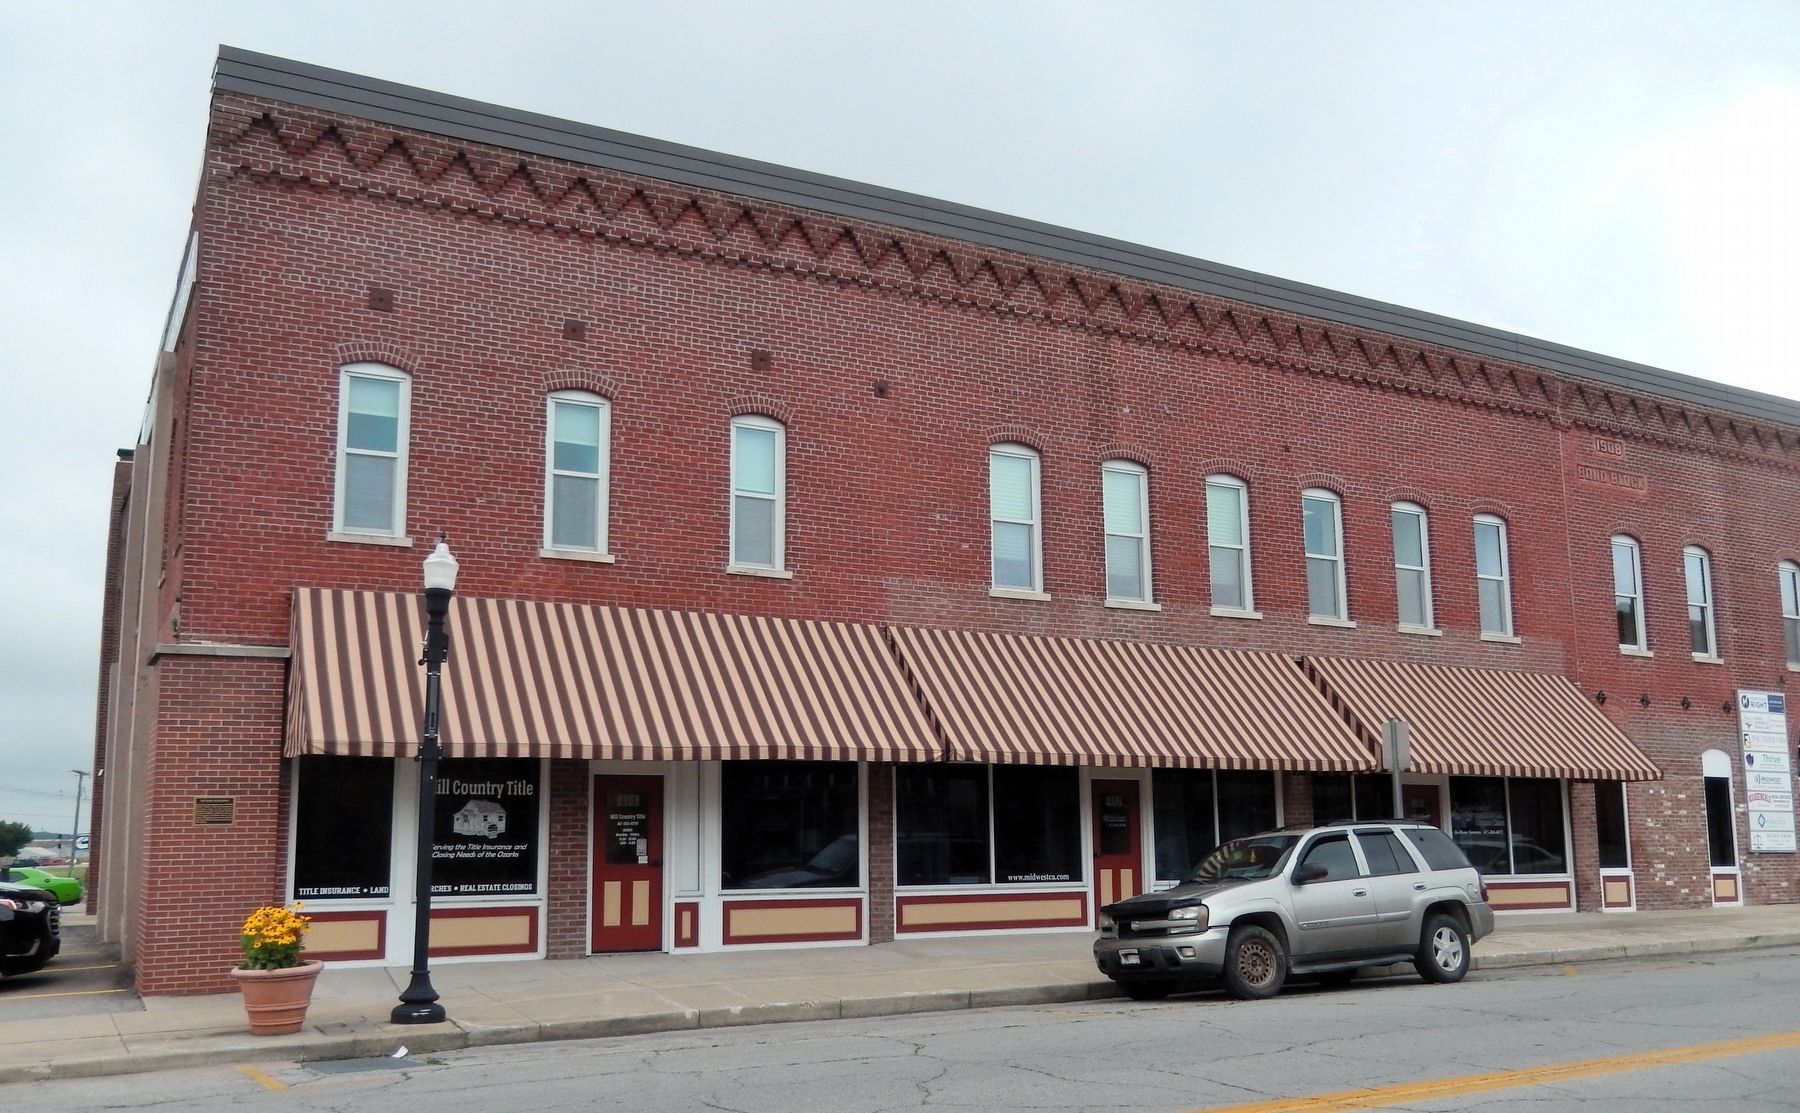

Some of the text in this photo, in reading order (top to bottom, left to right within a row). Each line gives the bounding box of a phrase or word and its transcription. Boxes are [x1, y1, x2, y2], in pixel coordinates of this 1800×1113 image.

[1595, 439, 1622, 456] 1908
[437, 779, 534, 798] ill Country Title
[468, 843, 481, 851] Title
[299, 886, 389, 896] TITLE INSURANCE LAND
[502, 883, 533, 891] CLOSINGS
